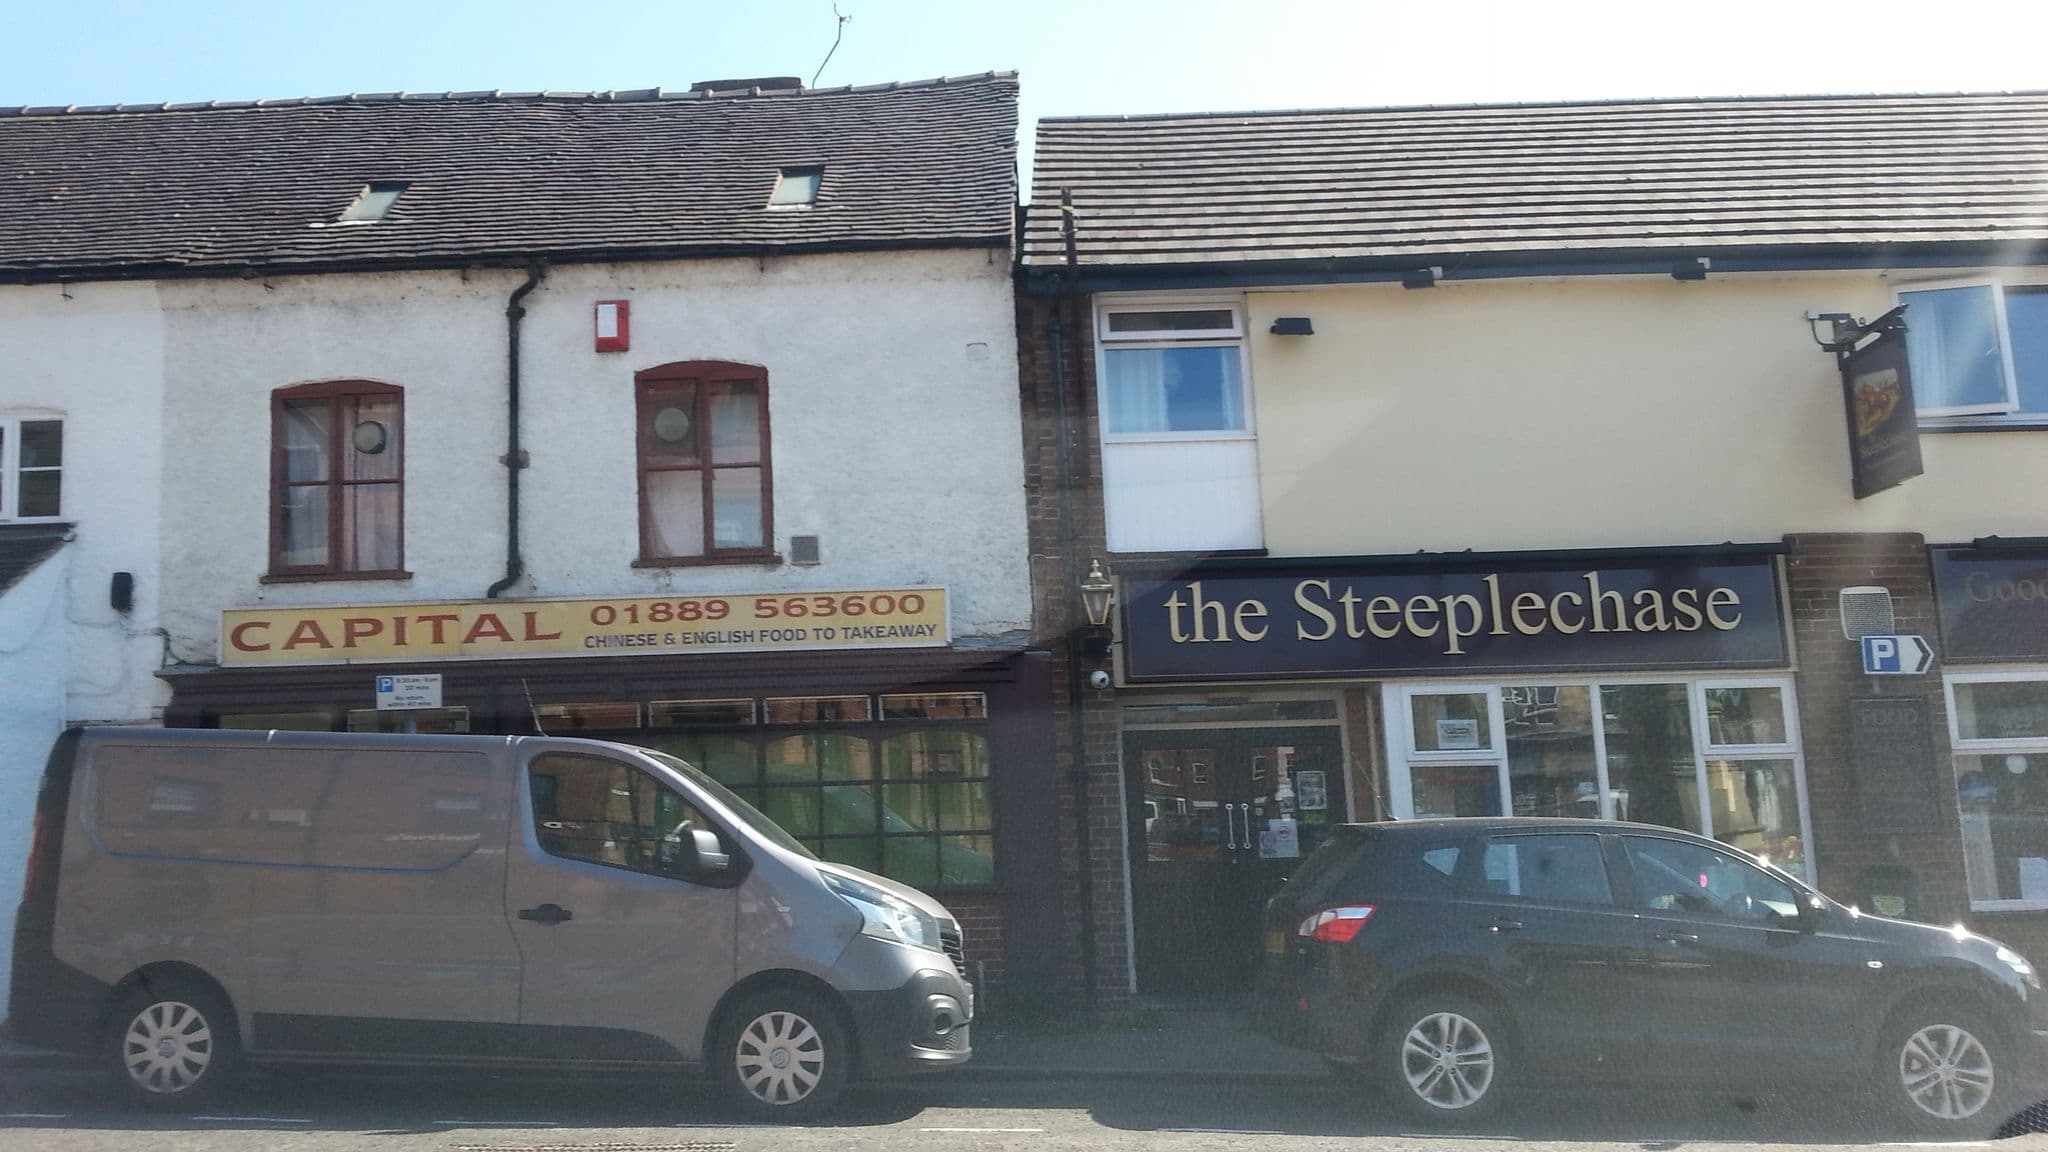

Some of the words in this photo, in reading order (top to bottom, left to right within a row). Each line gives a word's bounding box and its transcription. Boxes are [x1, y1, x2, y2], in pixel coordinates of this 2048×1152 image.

[590, 599, 730, 626] 01889
[754, 593, 925, 619] 563600
[1163, 582, 1269, 643] the
[1295, 571, 1742, 656] Steeplechase
[230, 611, 562, 652] CAPITAL
[584, 632, 657, 649] CHINESE
[663, 632, 676, 645] &
[683, 629, 754, 645] ENGLISH
[759, 627, 807, 642] FOOD
[814, 626, 836, 641] TO
[843, 623, 937, 640] TAKEAWAY
[1871, 639, 1895, 670] P
